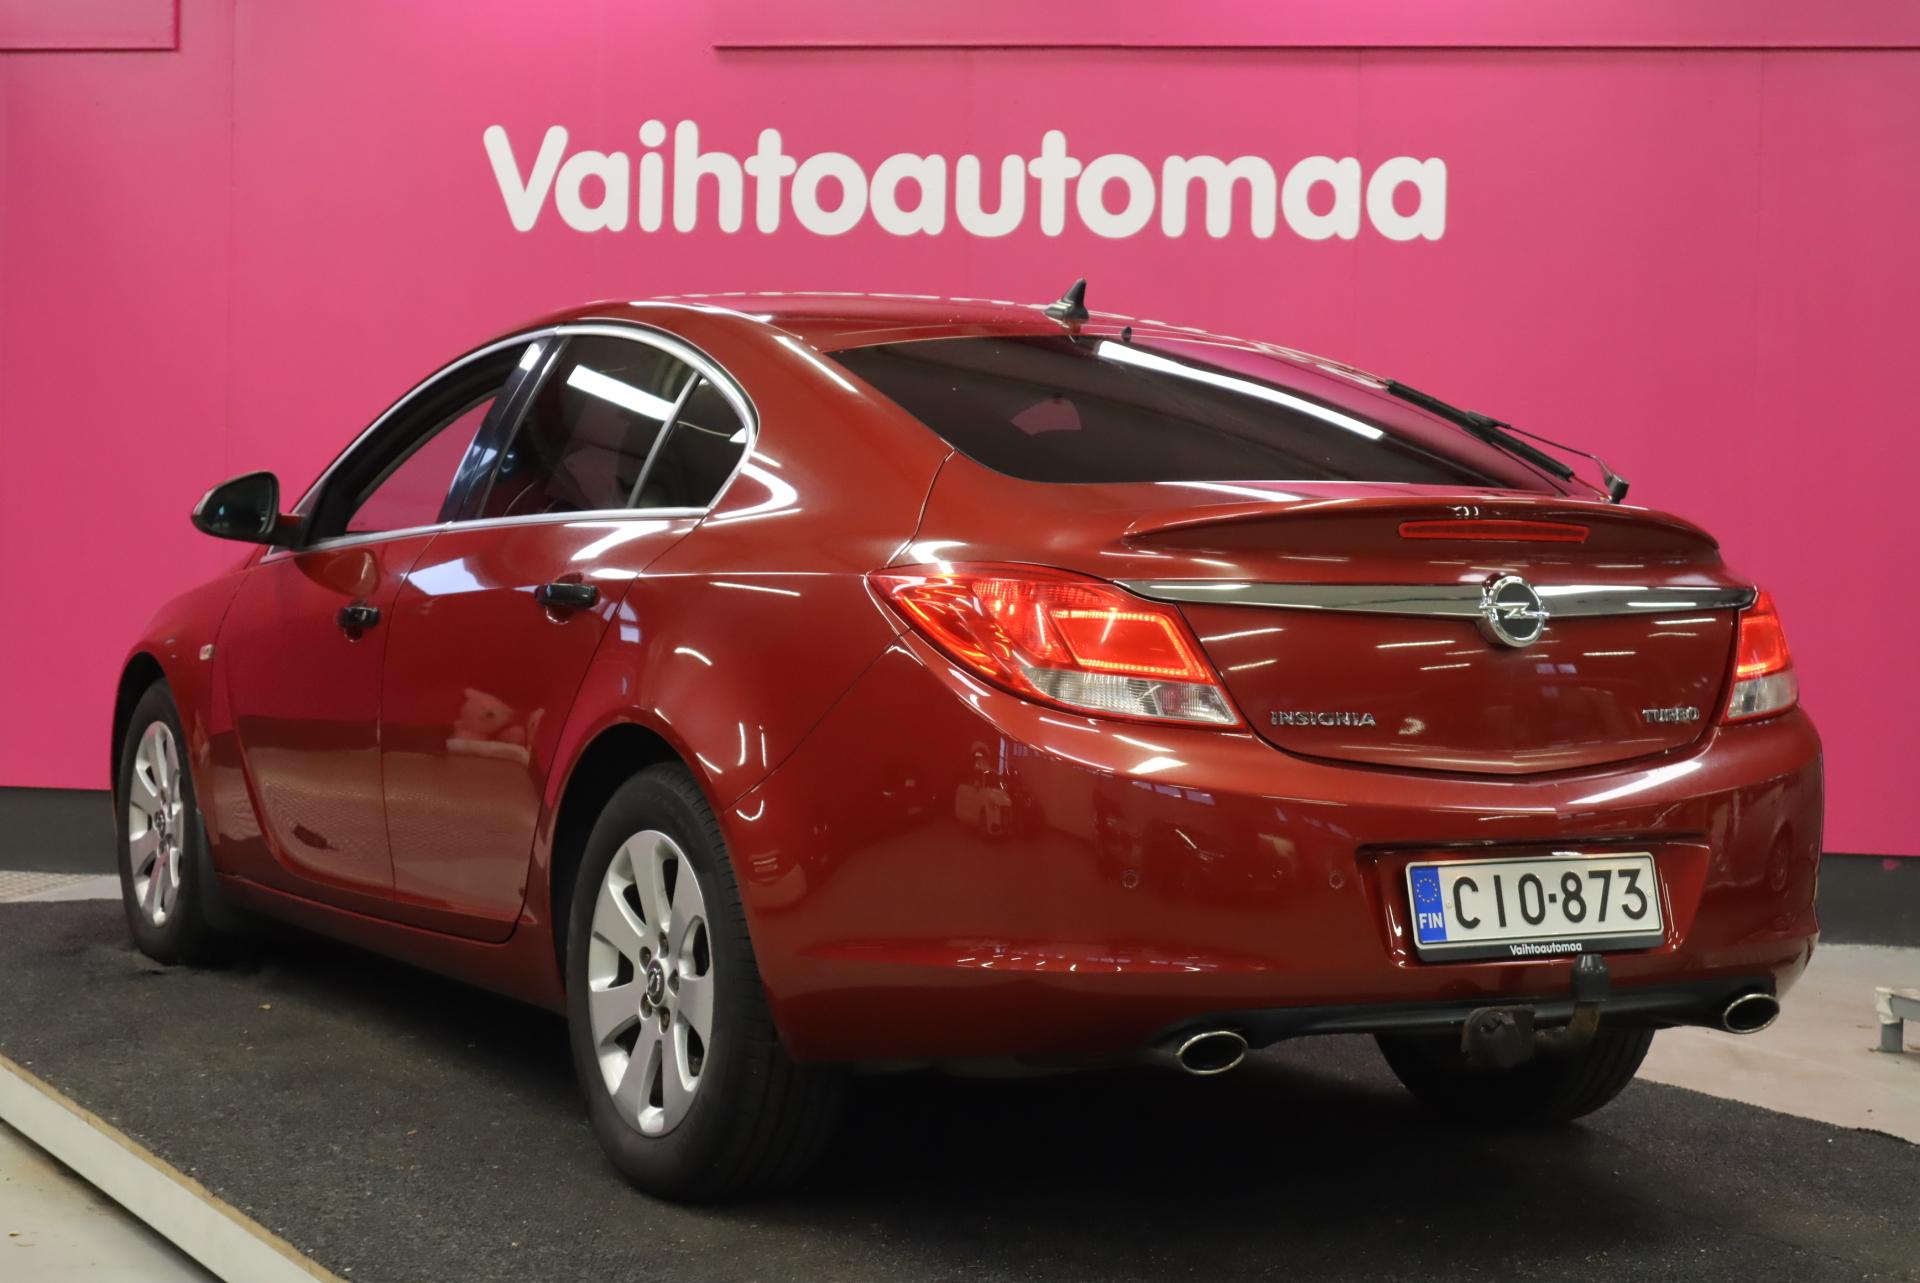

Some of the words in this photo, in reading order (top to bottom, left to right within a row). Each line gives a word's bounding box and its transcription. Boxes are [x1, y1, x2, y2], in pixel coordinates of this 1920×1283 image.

[483, 120, 1447, 242] Vaihtoautomaa
[1270, 711, 1376, 727] INSIGNIA
[1642, 706, 1700, 723] TURBO
[1453, 868, 1648, 930] CIO-873
[1418, 912, 1444, 929] FIN
[1510, 942, 1582, 956] Vaihtoautomaa
